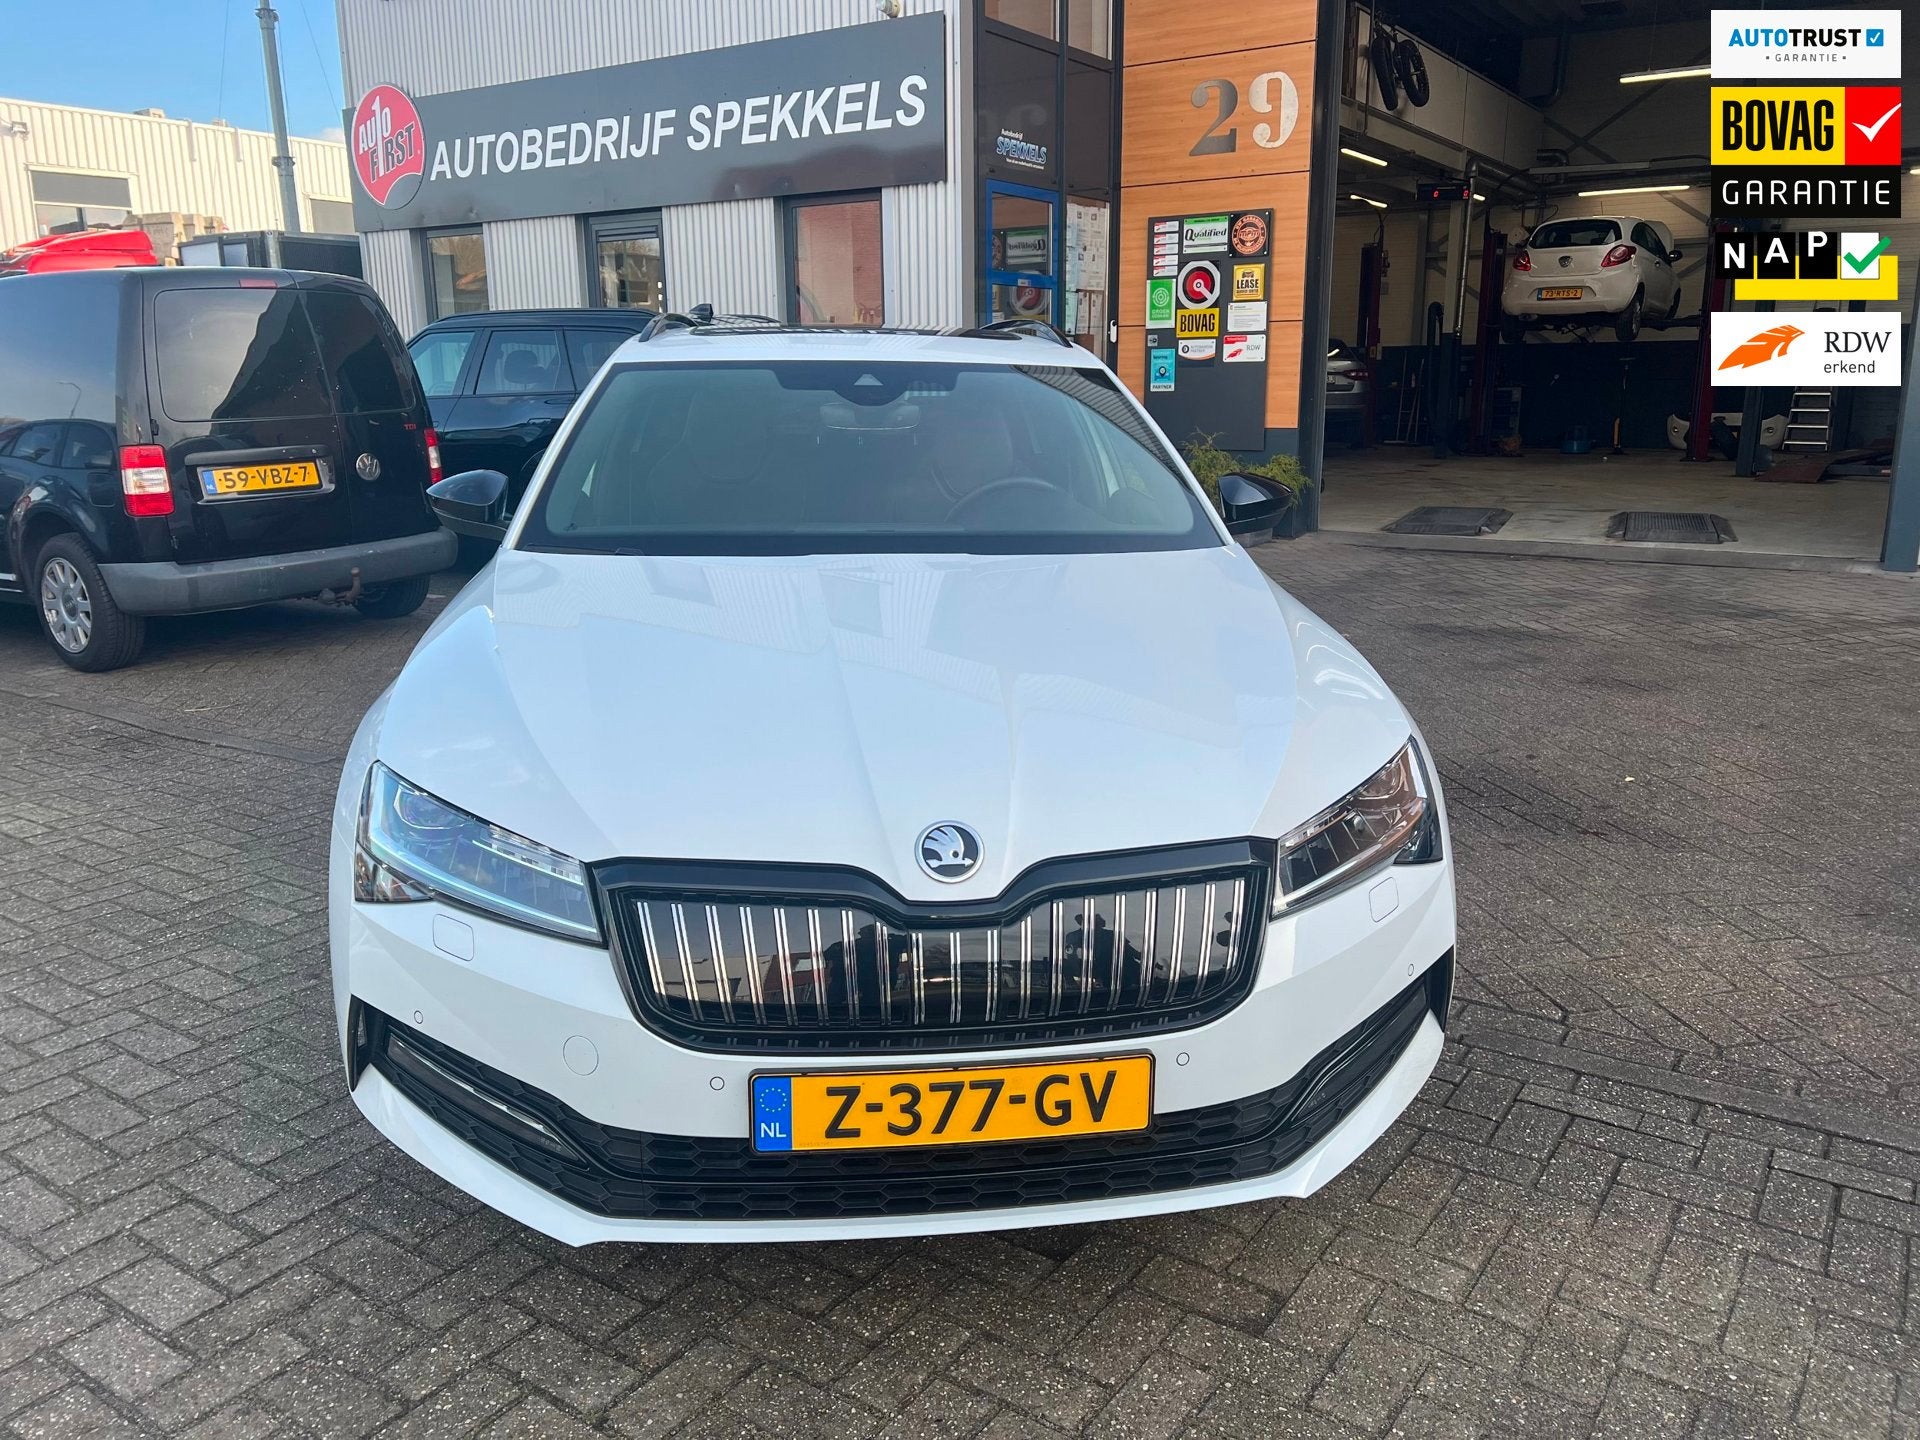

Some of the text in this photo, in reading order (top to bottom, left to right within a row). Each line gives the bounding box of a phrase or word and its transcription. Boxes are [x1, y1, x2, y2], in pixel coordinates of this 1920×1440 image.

[1189, 71, 1299, 156] 29
[430, 74, 928, 182] AUTOBEDRIJF SPEKKELS
[996, 135, 1047, 165] SPEKKELS
[1184, 227, 1227, 242] Qualified
[1236, 278, 1259, 290] LEASE
[1180, 313, 1215, 333] BOVAG
[222, 466, 308, 490] 59-VBZ-7
[825, 1069, 1118, 1140] Z-377-GV
[760, 1122, 787, 1139] NL
